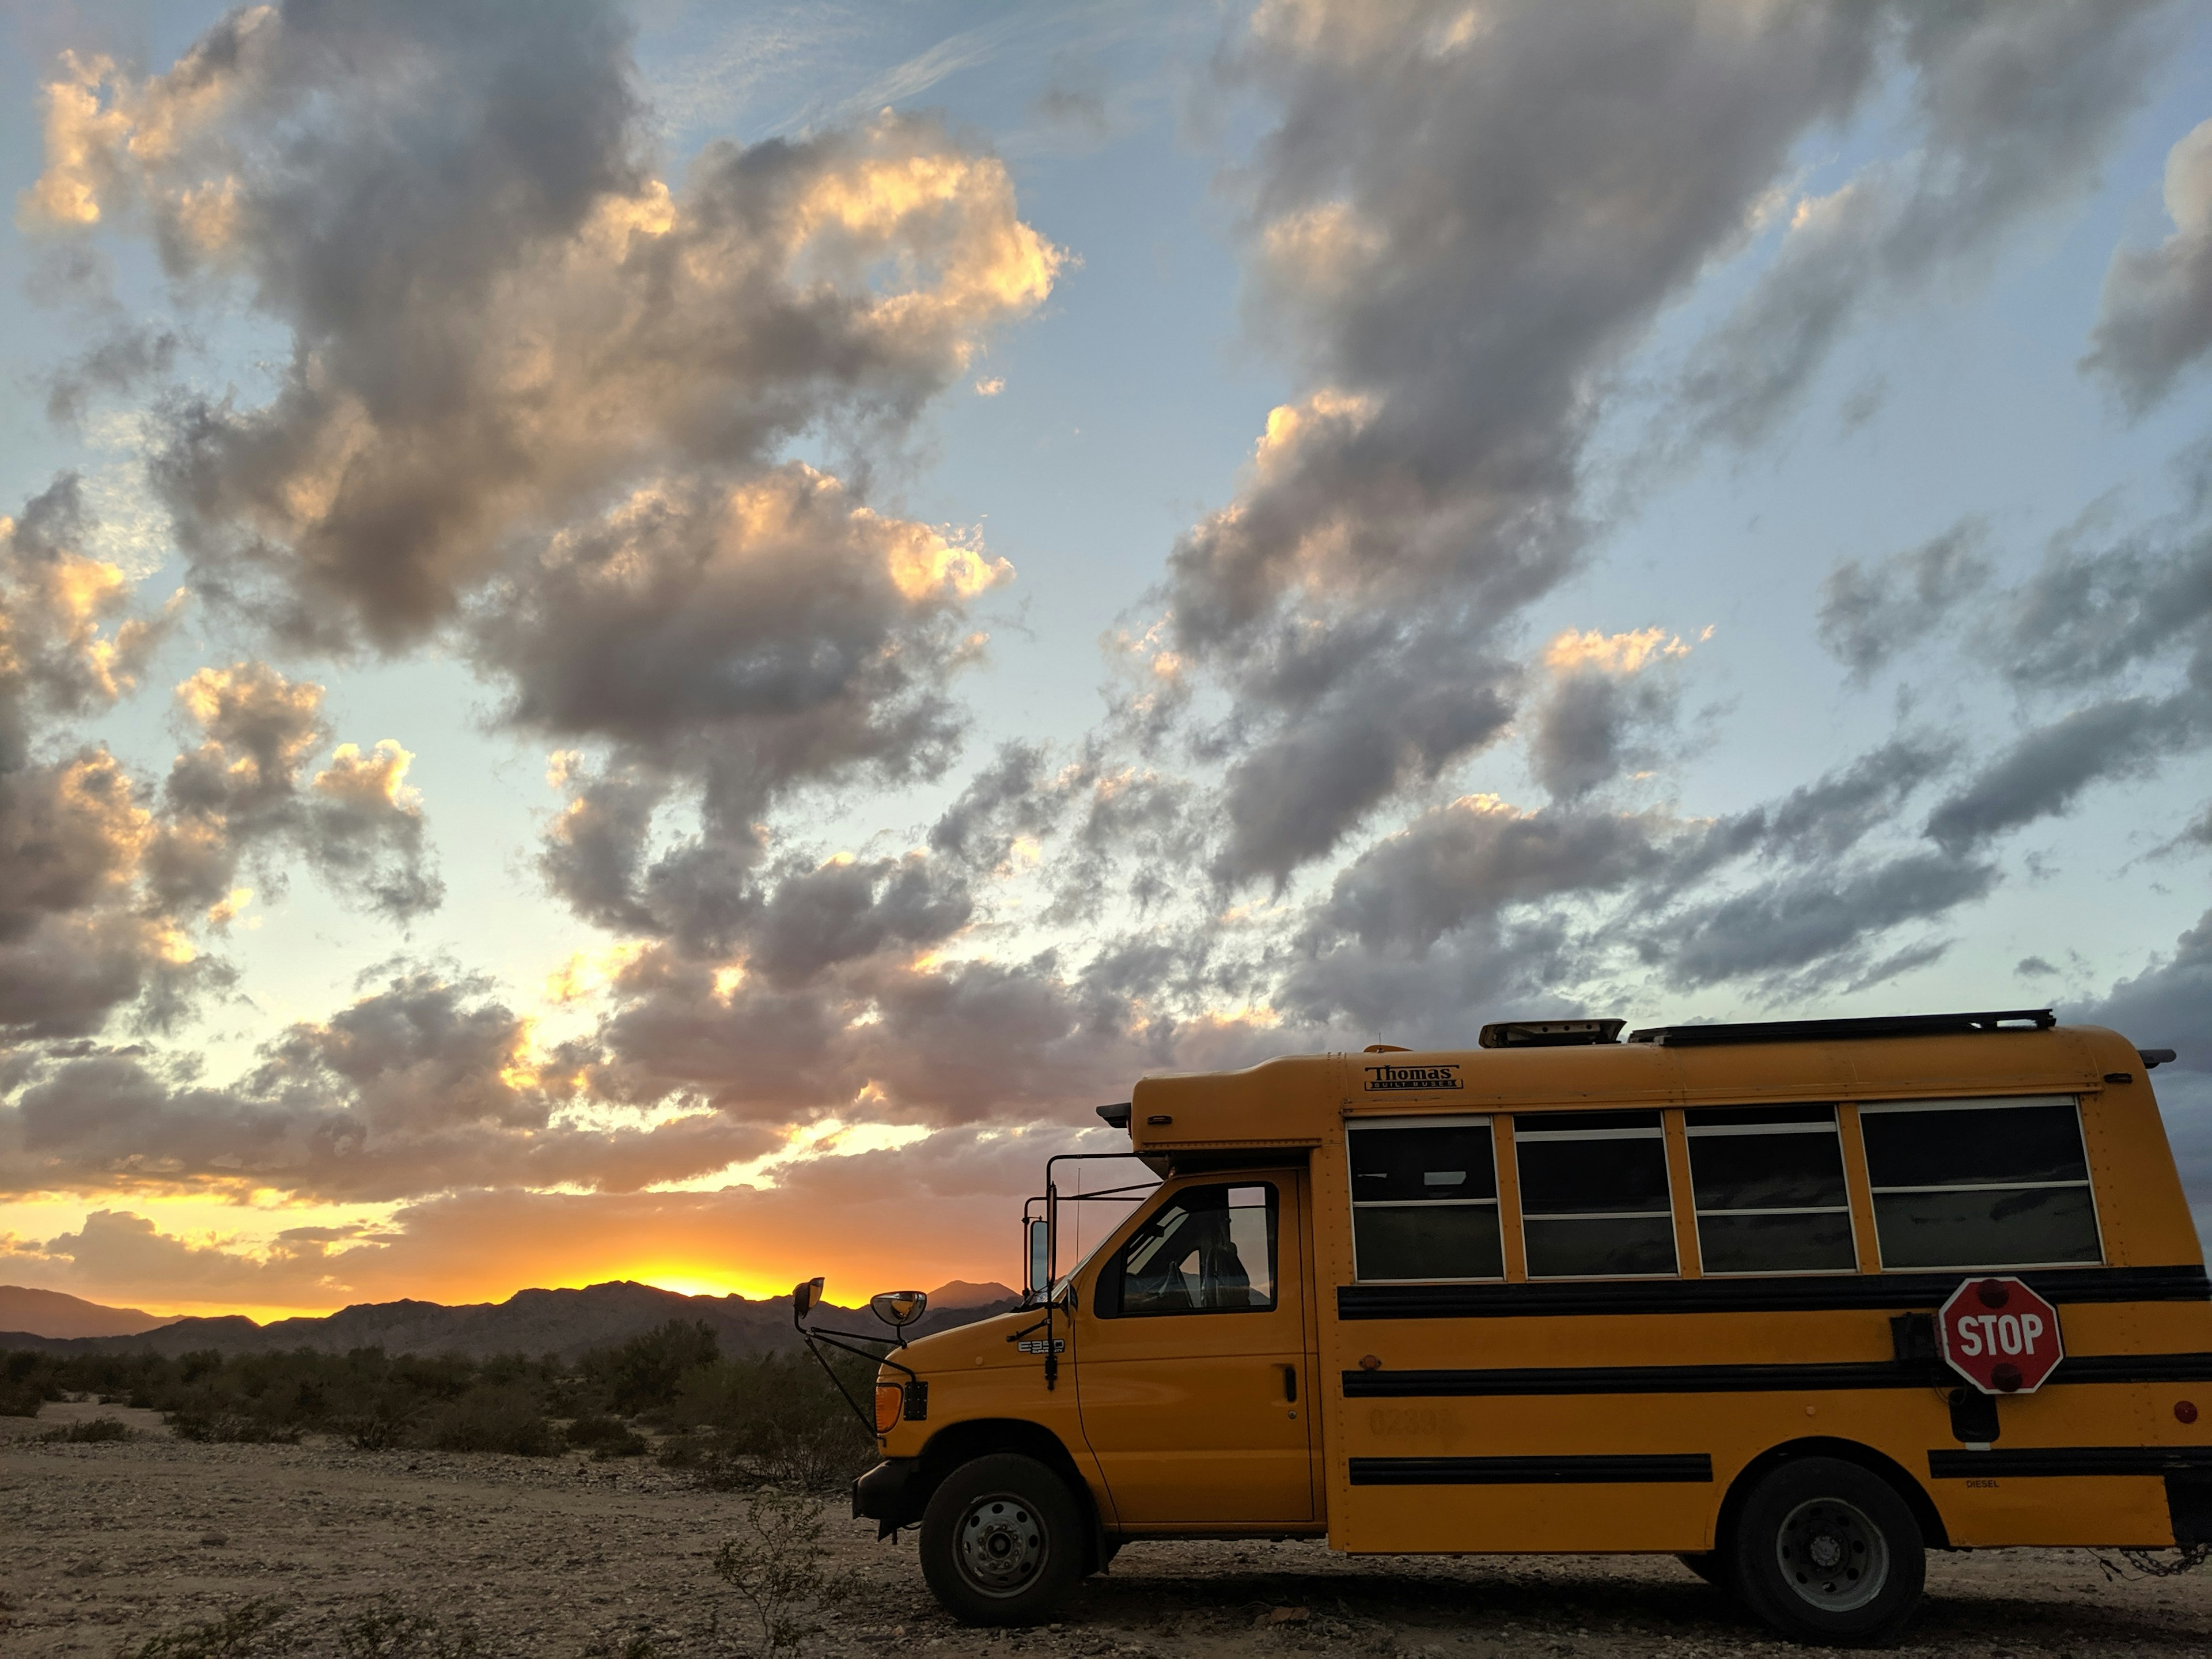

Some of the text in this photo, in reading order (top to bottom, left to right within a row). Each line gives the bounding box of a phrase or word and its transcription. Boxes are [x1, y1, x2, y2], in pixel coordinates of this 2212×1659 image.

[1365, 1065, 1459, 1081] Thomas
[1957, 1313, 2043, 1356] STOP
[1966, 1480, 2000, 1488] DIESEL
